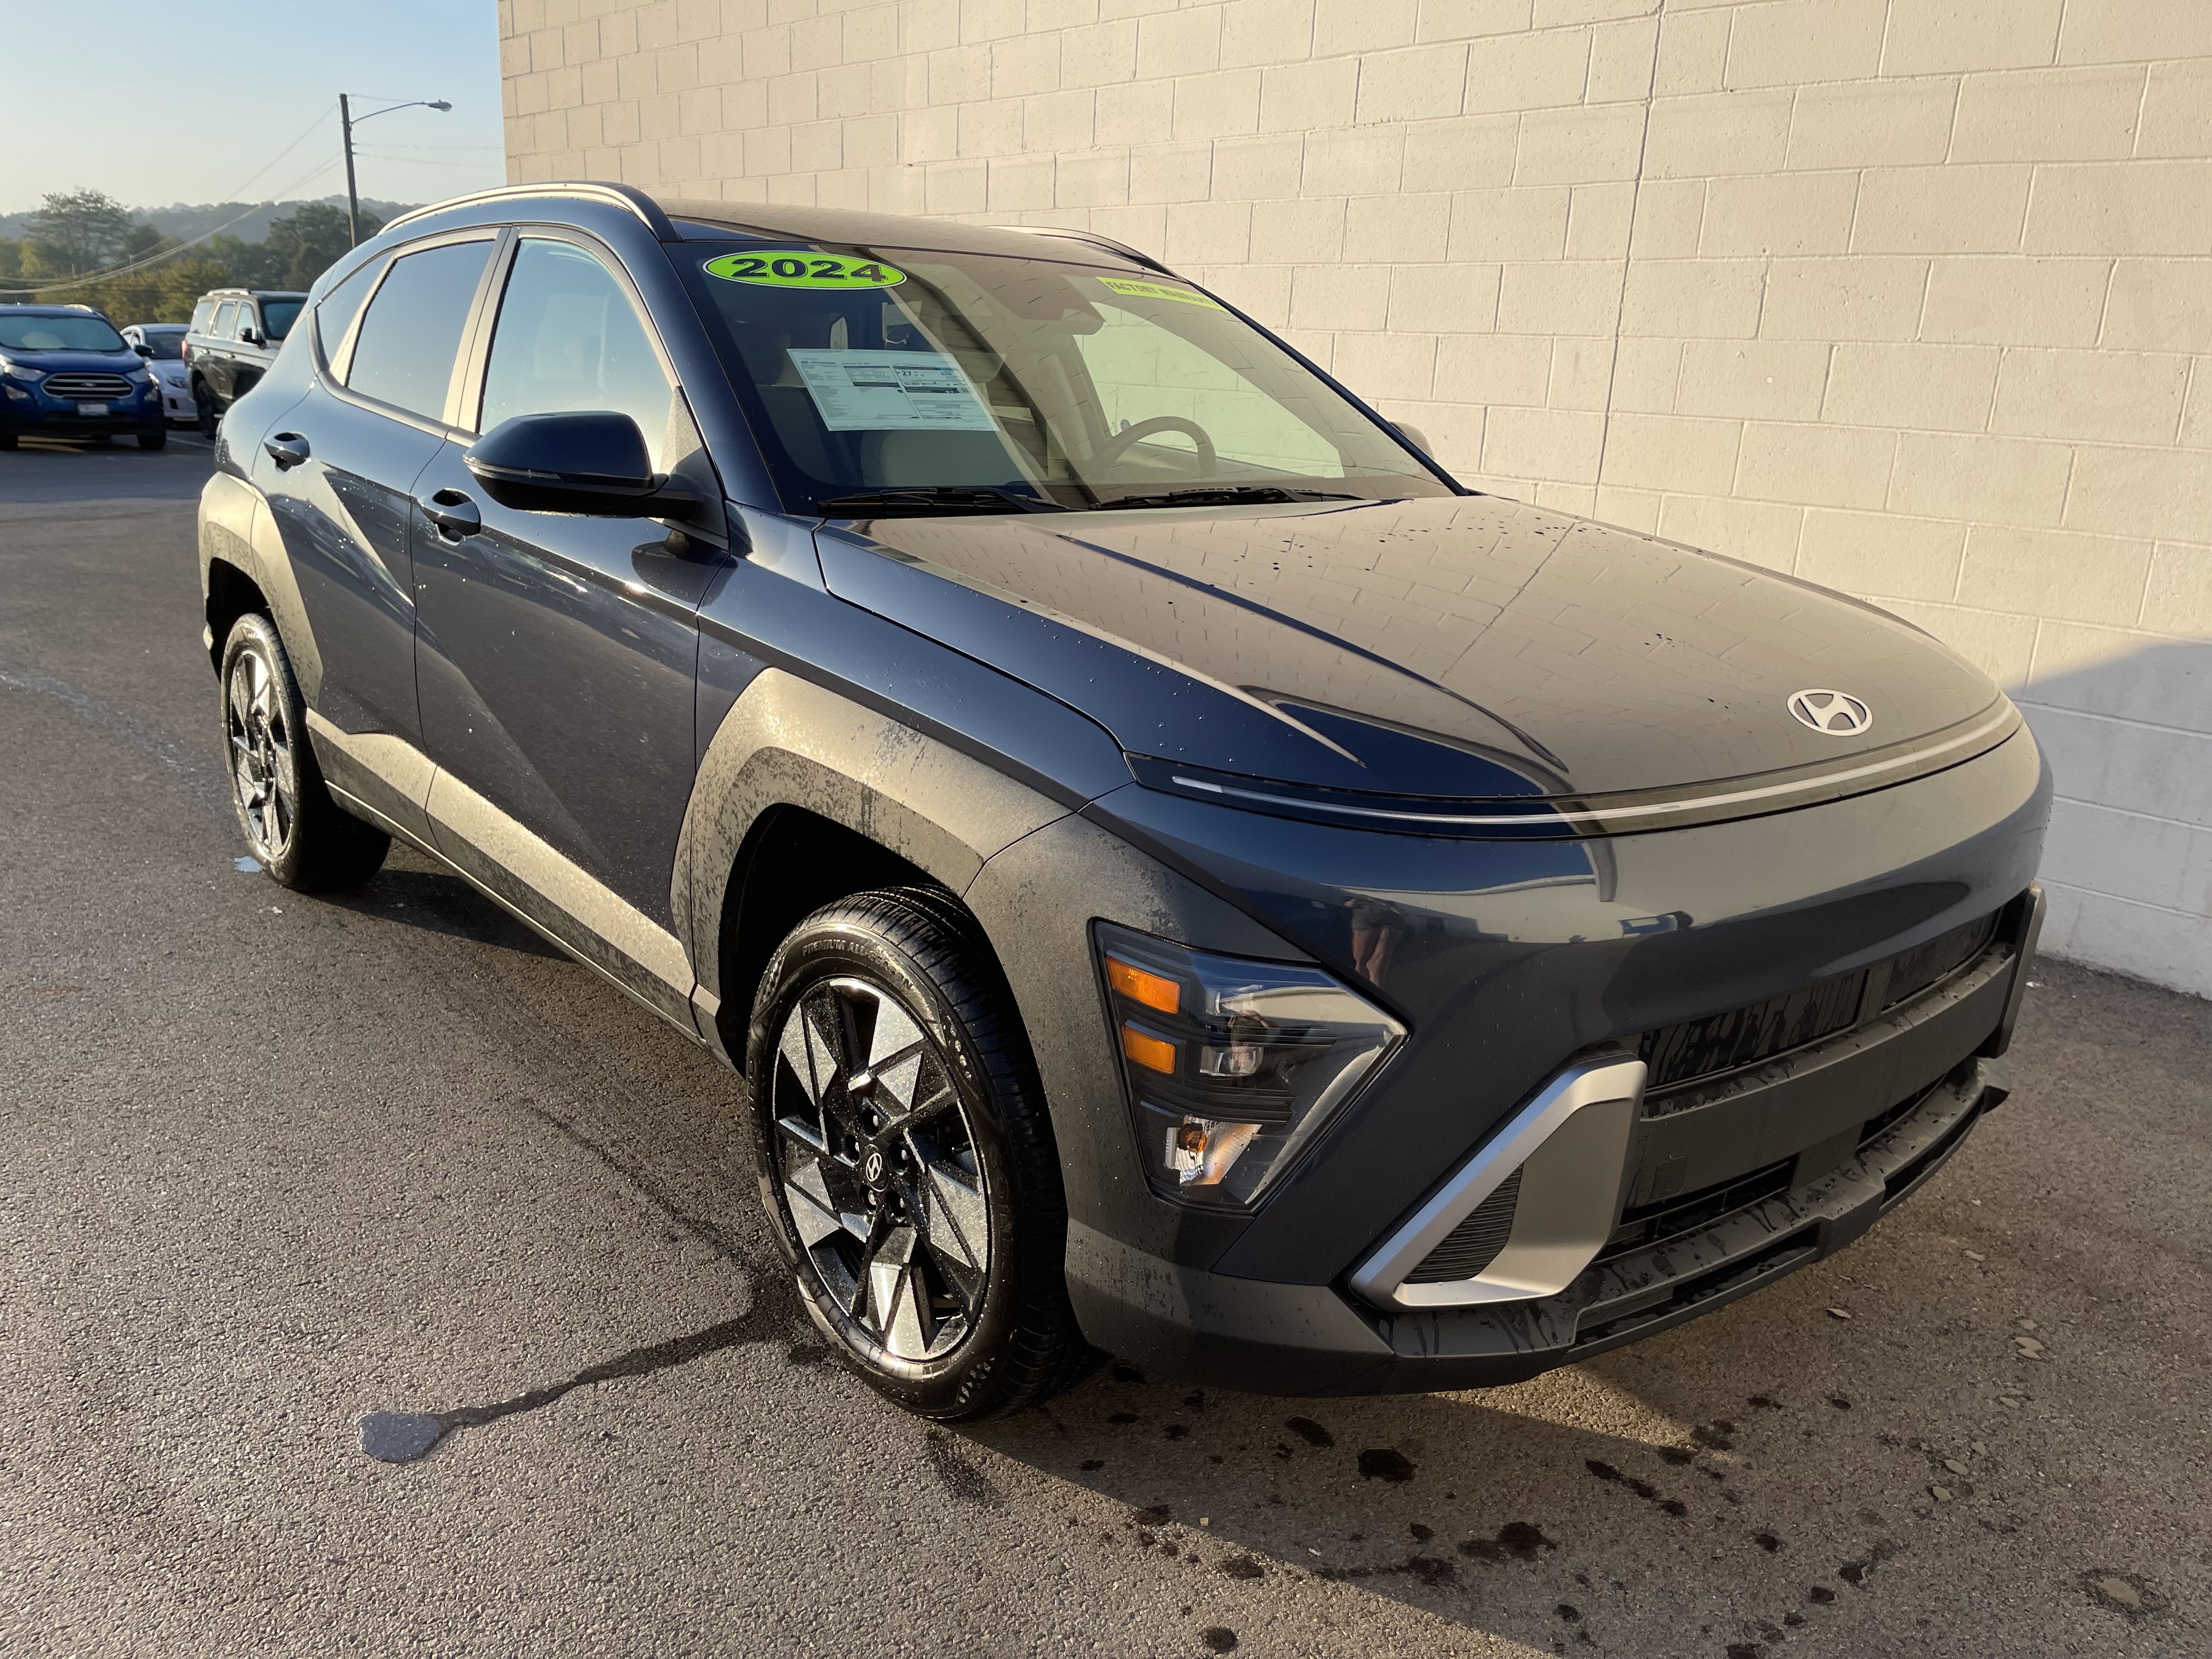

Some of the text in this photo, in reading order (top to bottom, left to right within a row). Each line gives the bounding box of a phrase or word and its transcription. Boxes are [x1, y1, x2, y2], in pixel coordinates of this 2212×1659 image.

[732, 258, 888, 283] 2024
[1104, 281, 1159, 294] FACTORY
[802, 939, 845, 957] PREMIUM
